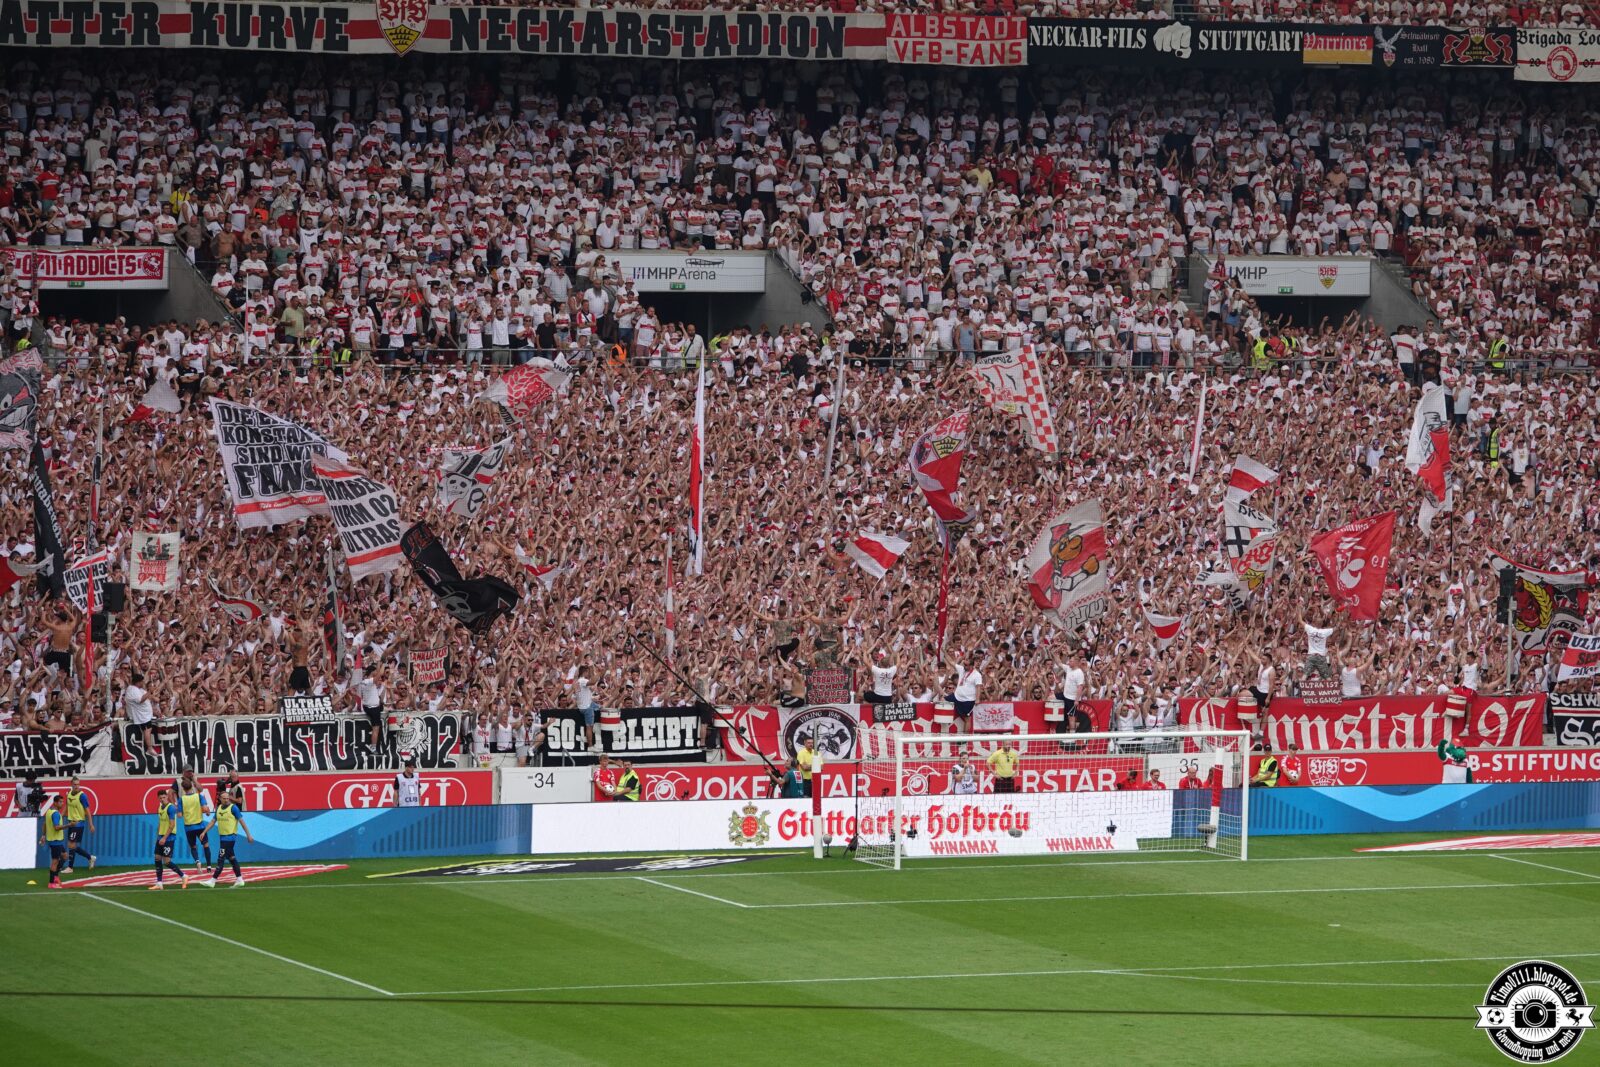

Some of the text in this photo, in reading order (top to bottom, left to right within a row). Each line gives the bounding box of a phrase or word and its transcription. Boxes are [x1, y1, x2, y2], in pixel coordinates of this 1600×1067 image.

[190, 2, 349, 52] KURVE
[450, 7, 847, 58] NECKARSTADION
[891, 15, 1028, 39] ALBSTADT
[1029, 24, 1303, 53] NECKAR-FILS STUTTGART
[1303, 31, 1368, 51] Warriors
[1517, 30, 1572, 48] Brigada
[893, 40, 1023, 65] VFB-FANS
[647, 267, 716, 280] MHP Arena
[1235, 266, 1268, 280] MHP
[217, 405, 254, 425] DIE
[238, 446, 283, 465] SIND
[284, 696, 332, 709] ULTRAS
[1550, 692, 1600, 707] SCHW
[286, 705, 333, 716] BEDEUTET
[286, 713, 336, 723] WIDERSTAND
[799, 710, 823, 723] VIKING
[1477, 697, 1536, 748] 97
[425, 714, 462, 769] 02
[930, 840, 999, 855] WINAMAX
[1046, 836, 1114, 853] WINAMAX
